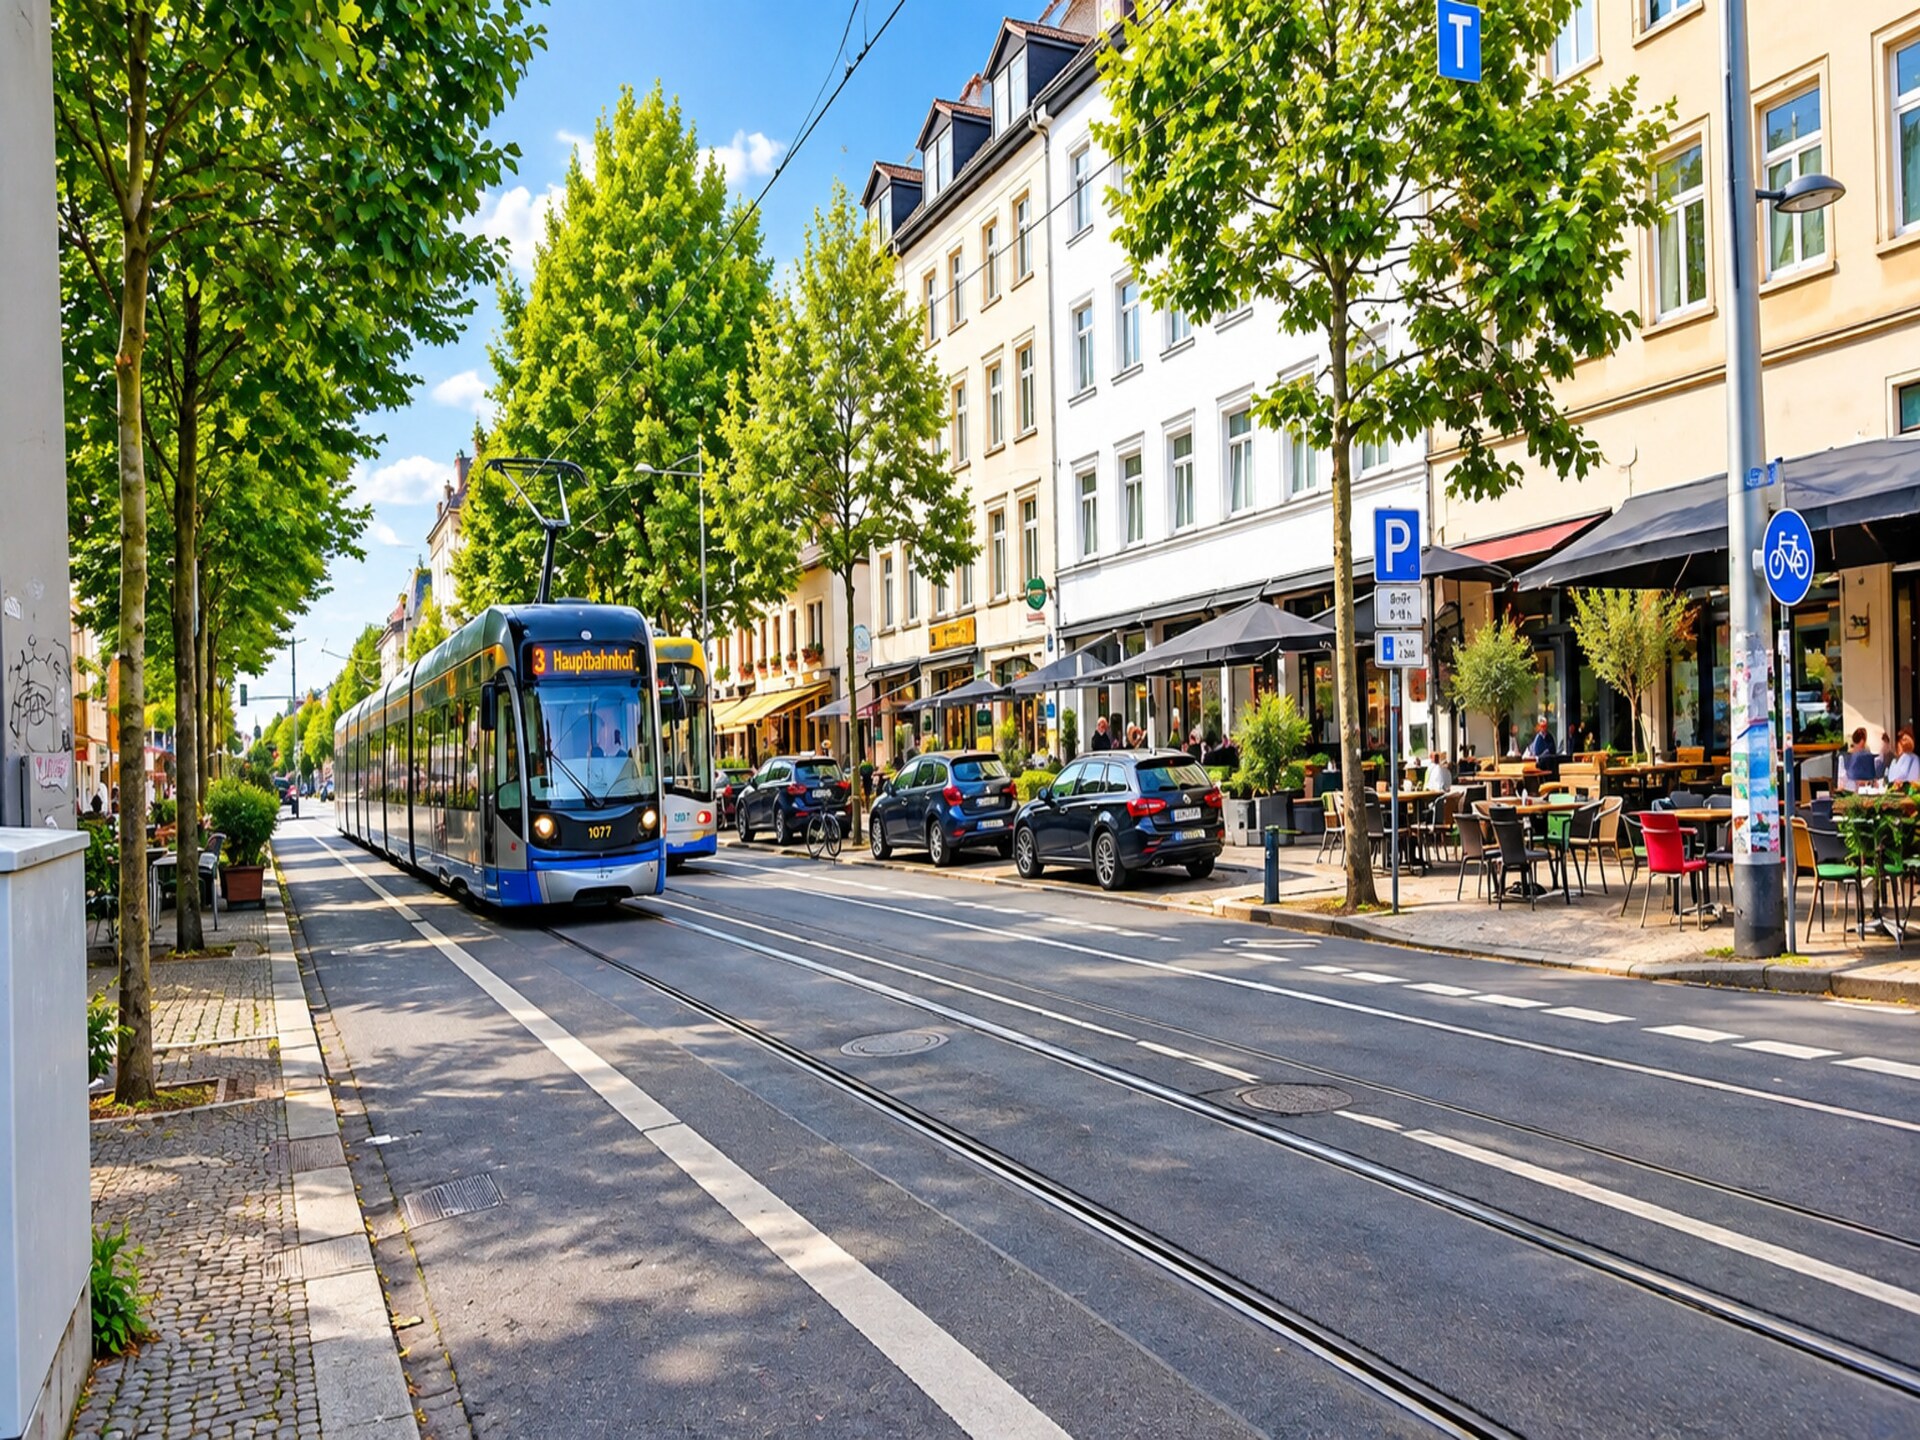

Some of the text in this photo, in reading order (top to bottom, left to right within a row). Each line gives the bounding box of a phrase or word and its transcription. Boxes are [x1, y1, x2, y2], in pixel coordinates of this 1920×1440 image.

[1448, 13, 1472, 69] T
[1385, 518, 1411, 573] P
[534, 648, 545, 672] 3
[588, 825, 611, 839] 1077
